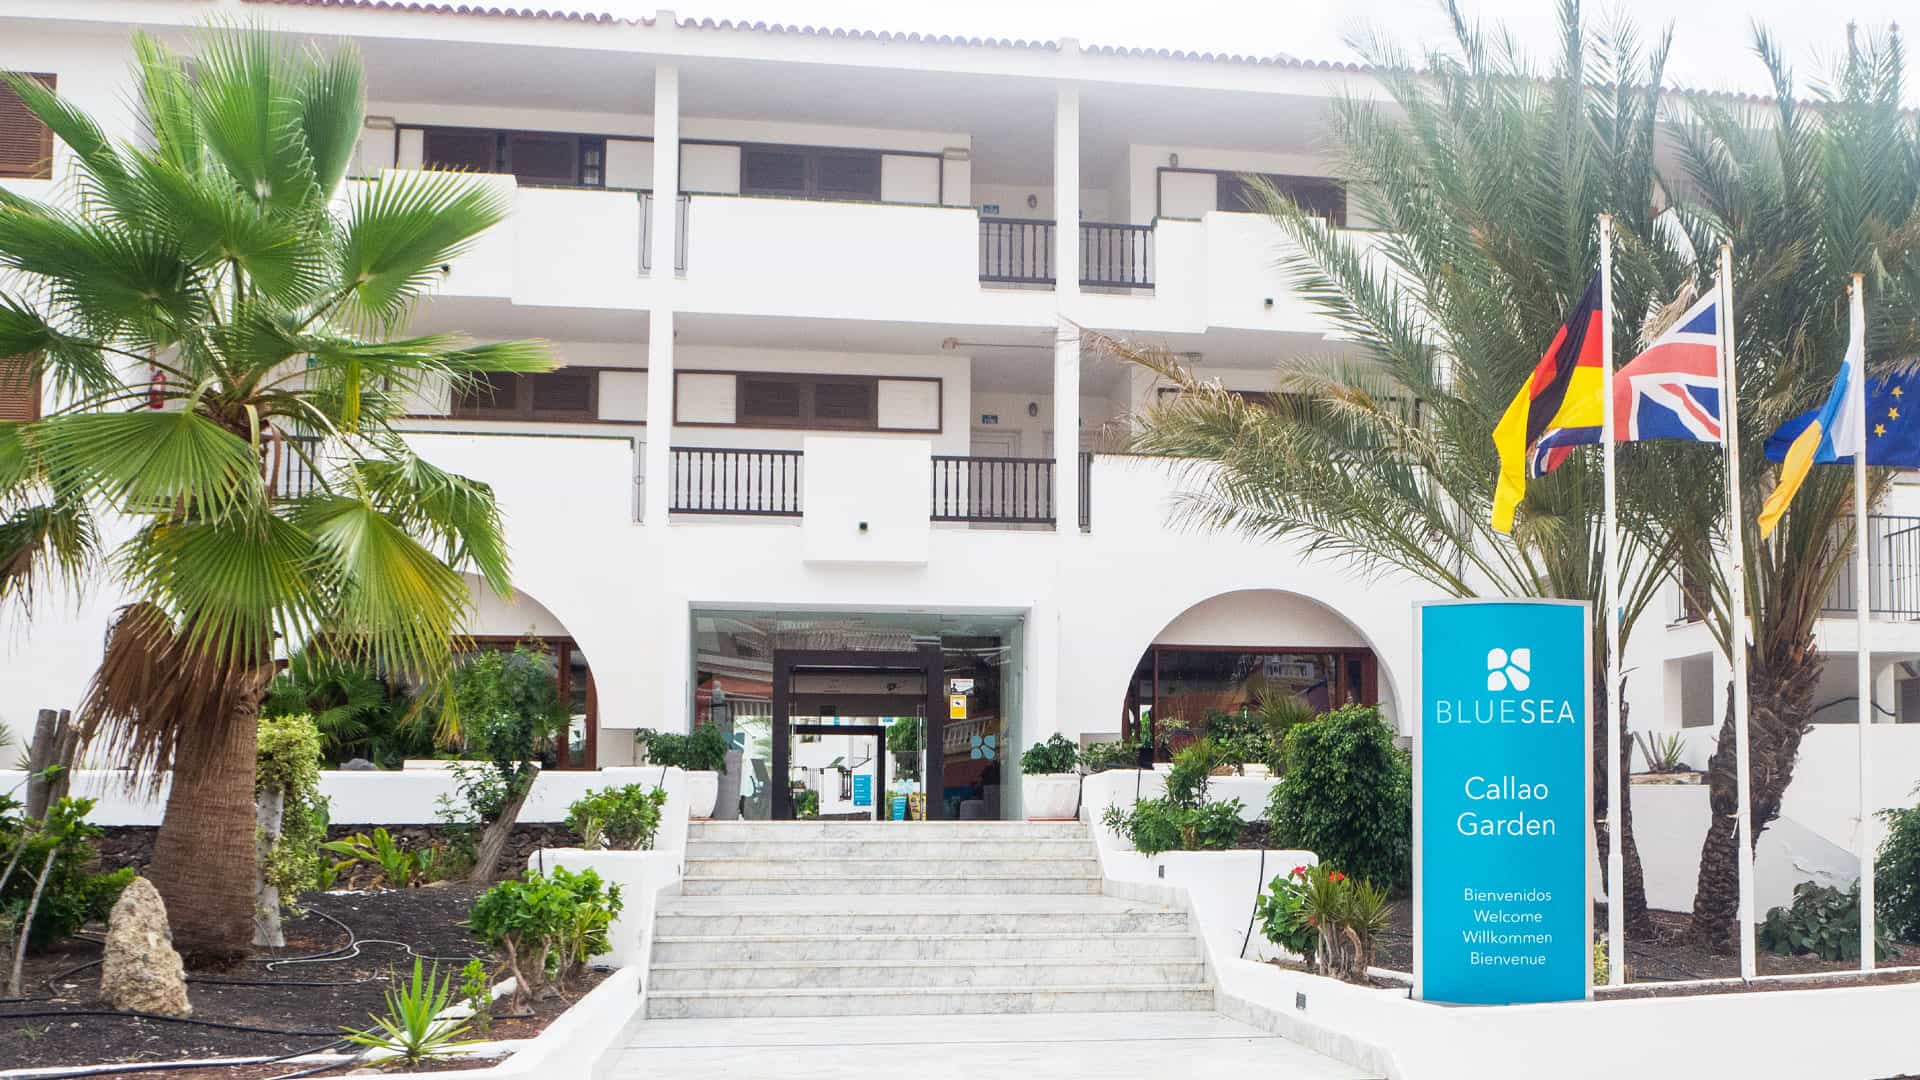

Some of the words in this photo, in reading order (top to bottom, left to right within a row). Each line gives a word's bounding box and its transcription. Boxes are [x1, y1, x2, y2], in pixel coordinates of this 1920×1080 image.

[1436, 699, 1575, 724] BLUESEA
[1464, 775, 1549, 800] Callao
[1456, 811, 1556, 836] Garden
[1463, 887, 1552, 902] Bienvenidos
[1473, 909, 1543, 923] Welcome
[1462, 929, 1553, 944] Willkommen
[1470, 951, 1546, 966] Bienvenue
